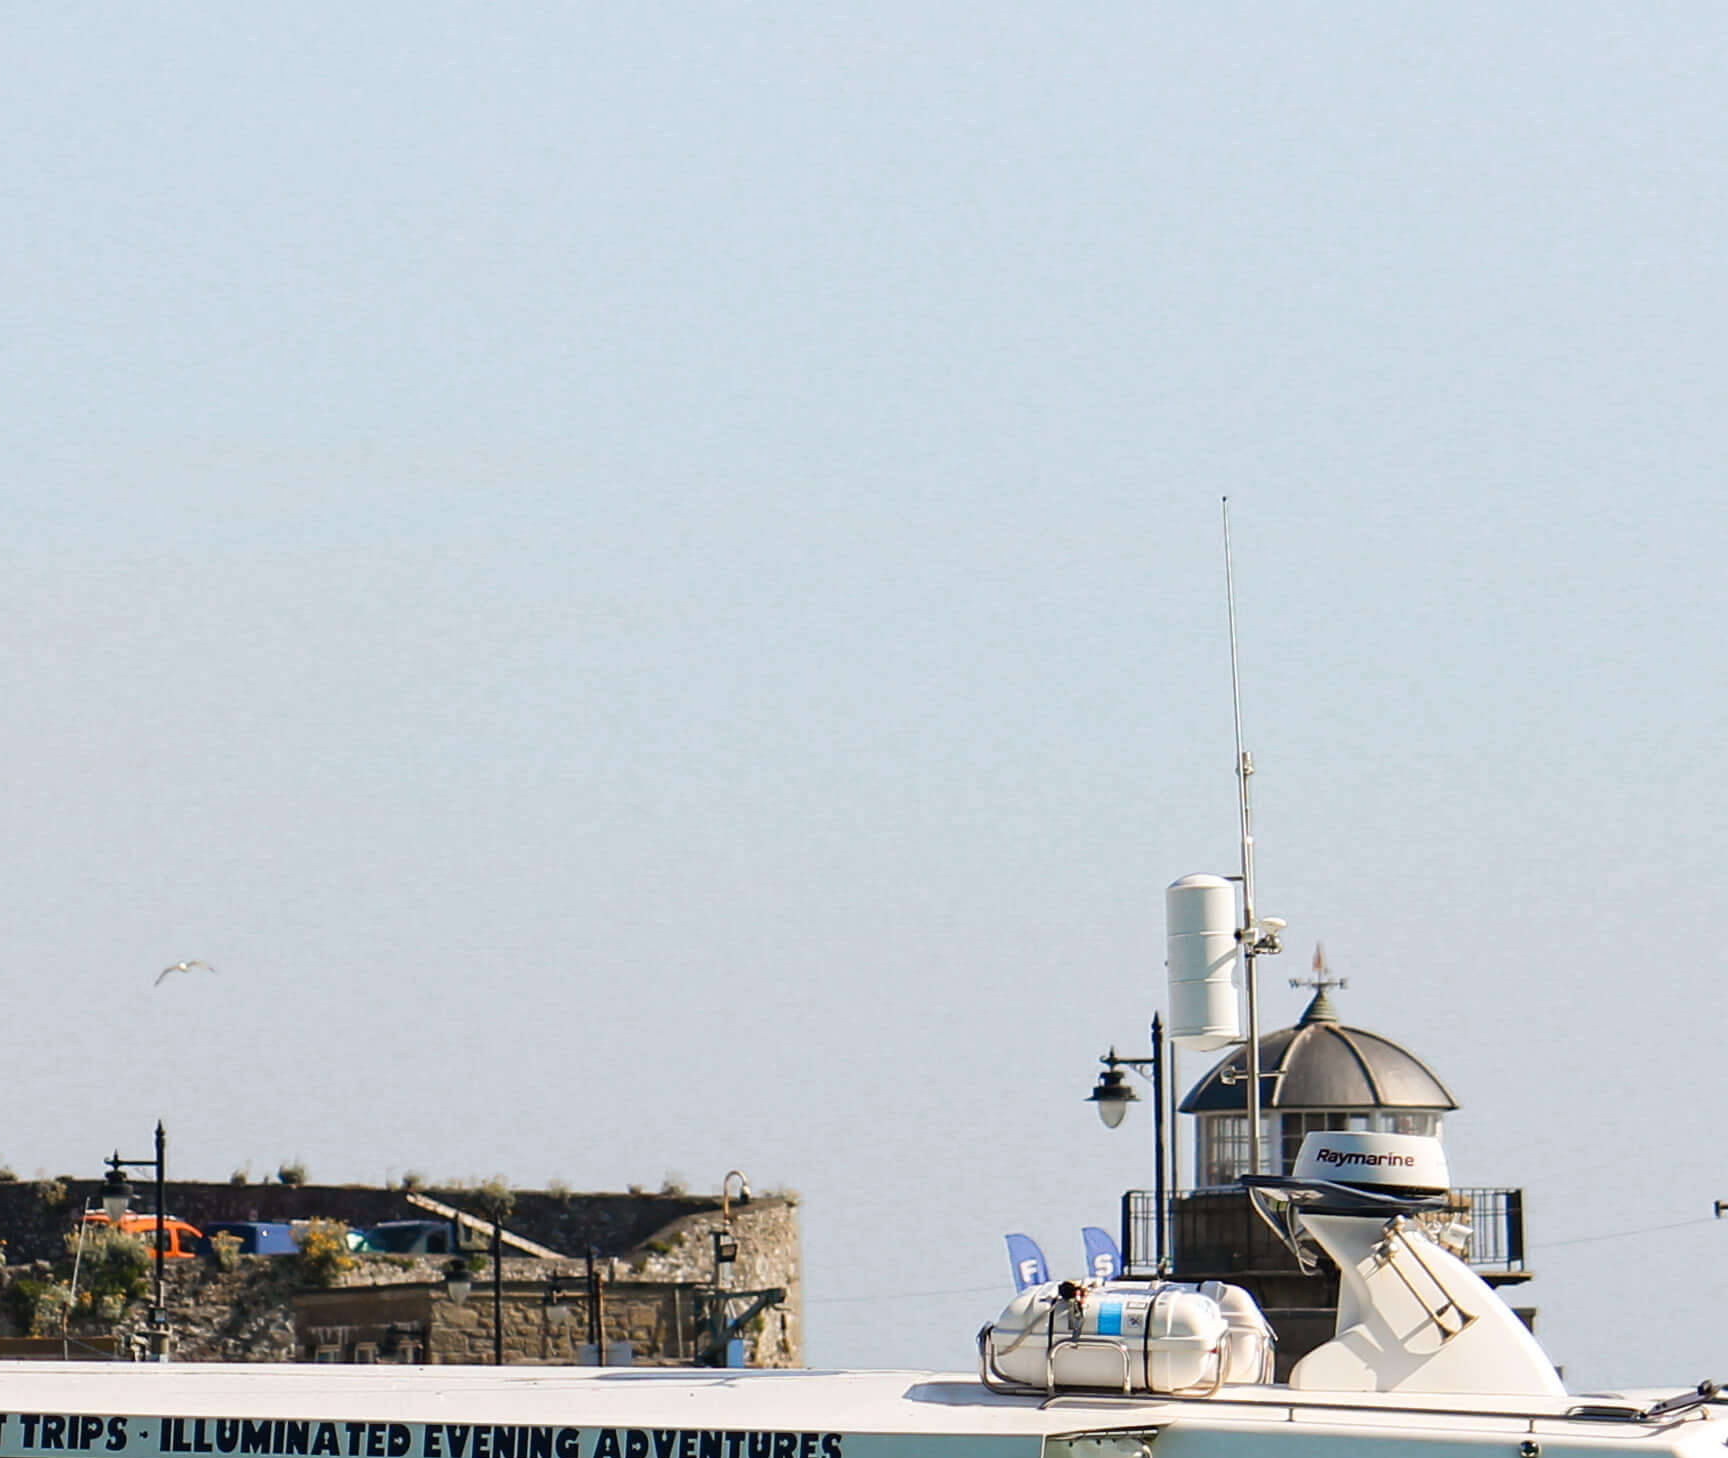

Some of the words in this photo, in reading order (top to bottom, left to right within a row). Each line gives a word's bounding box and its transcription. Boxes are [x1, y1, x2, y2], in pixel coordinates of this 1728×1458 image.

[1316, 1148, 1414, 1168] Raymarine
[1019, 1259, 1038, 1283] F
[1094, 1253, 1113, 1277] S
[19, 1414, 129, 1452] TRIPS
[159, 1418, 412, 1458] ILLUMINATED
